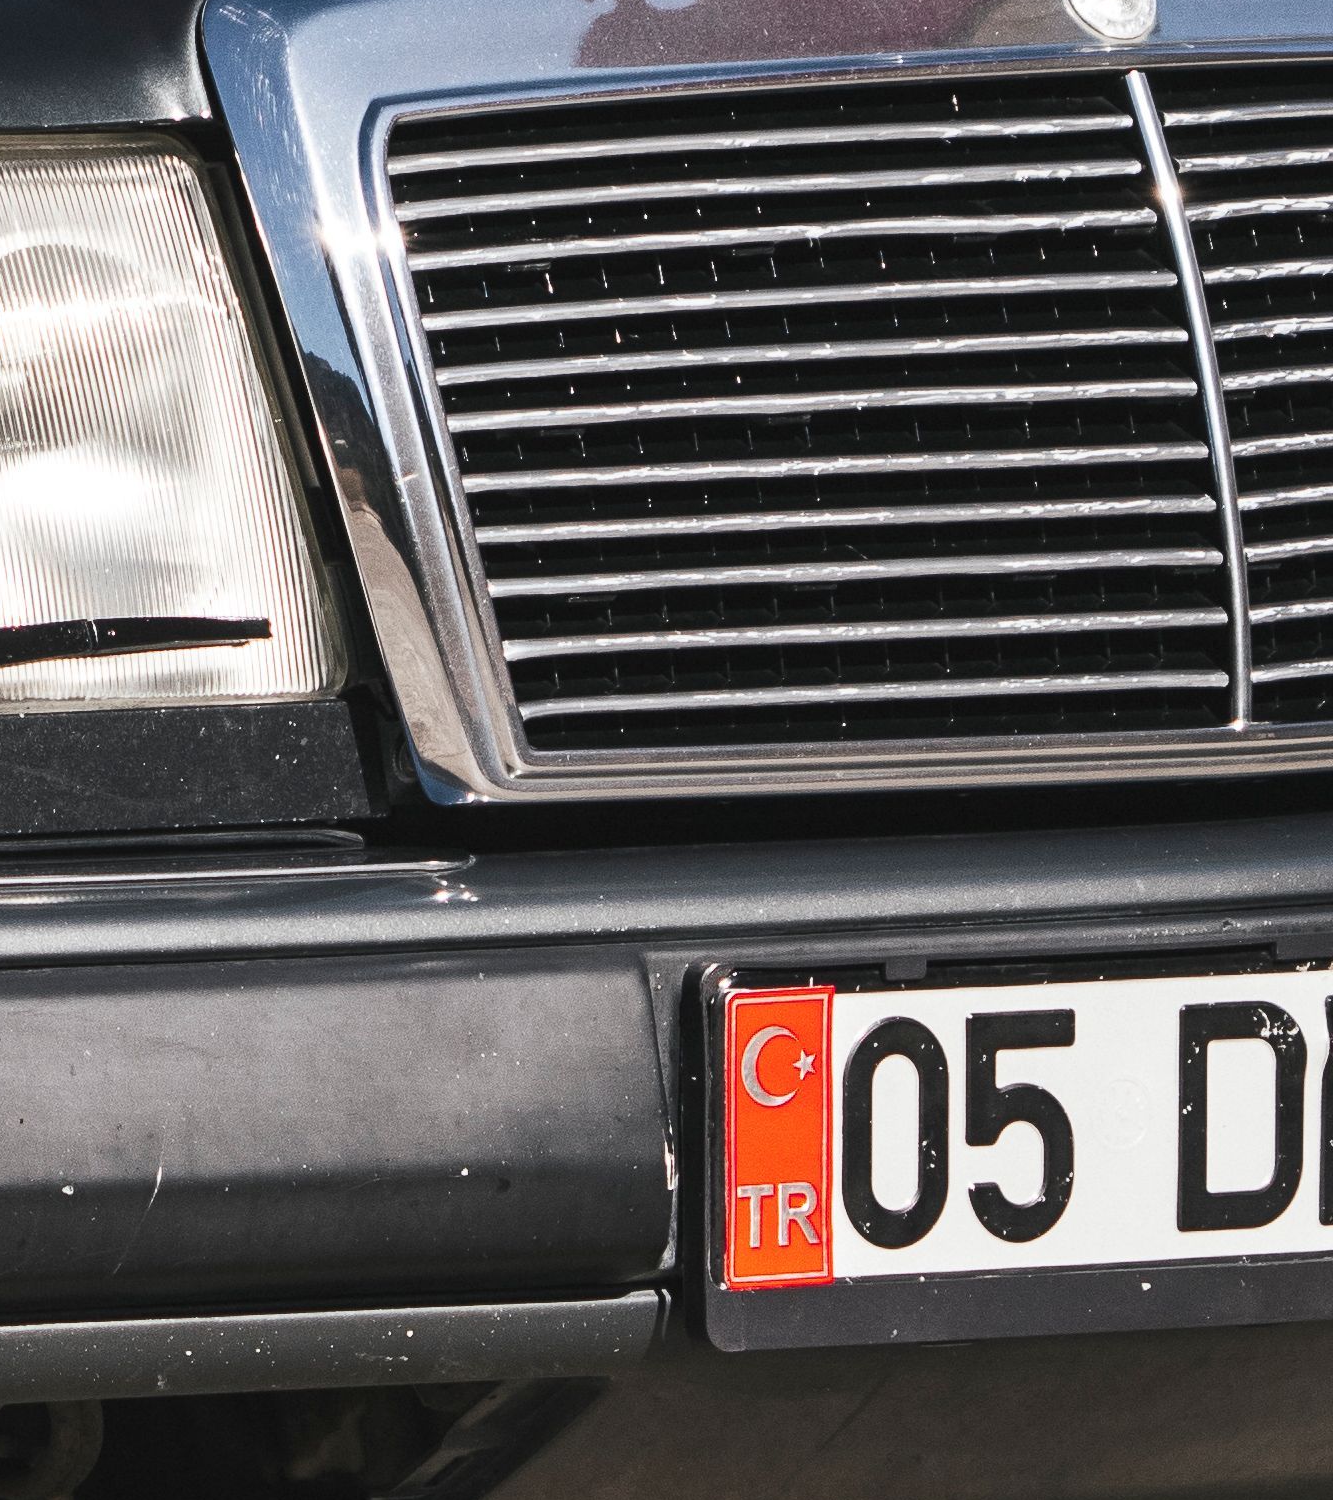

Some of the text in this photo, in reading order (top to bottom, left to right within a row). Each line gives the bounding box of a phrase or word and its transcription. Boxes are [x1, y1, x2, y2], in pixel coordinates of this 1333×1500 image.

[841, 996, 1333, 1249] 05 D
[736, 1181, 821, 1248] TR
